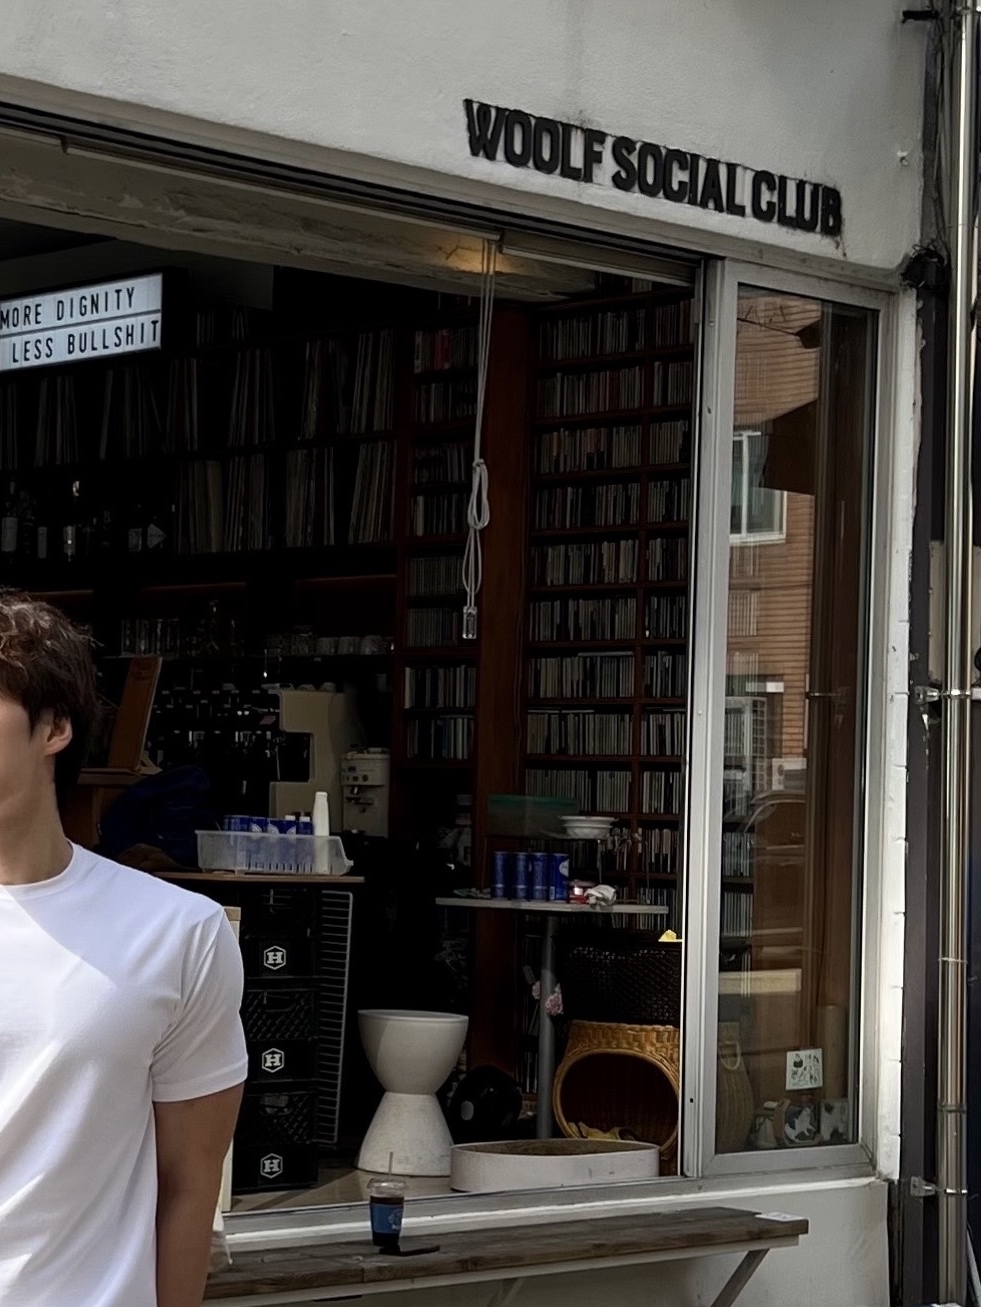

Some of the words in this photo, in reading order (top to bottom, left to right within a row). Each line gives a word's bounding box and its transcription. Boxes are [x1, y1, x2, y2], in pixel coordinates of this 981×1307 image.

[463, 98, 606, 182] WOOLF
[612, 136, 747, 216] SOCIAL
[751, 168, 843, 235] CLUB
[0, 303, 42, 330] MORE
[56, 286, 135, 321] DIGNITY
[12, 337, 54, 363] LESS
[68, 320, 159, 354] BULLSHIT
